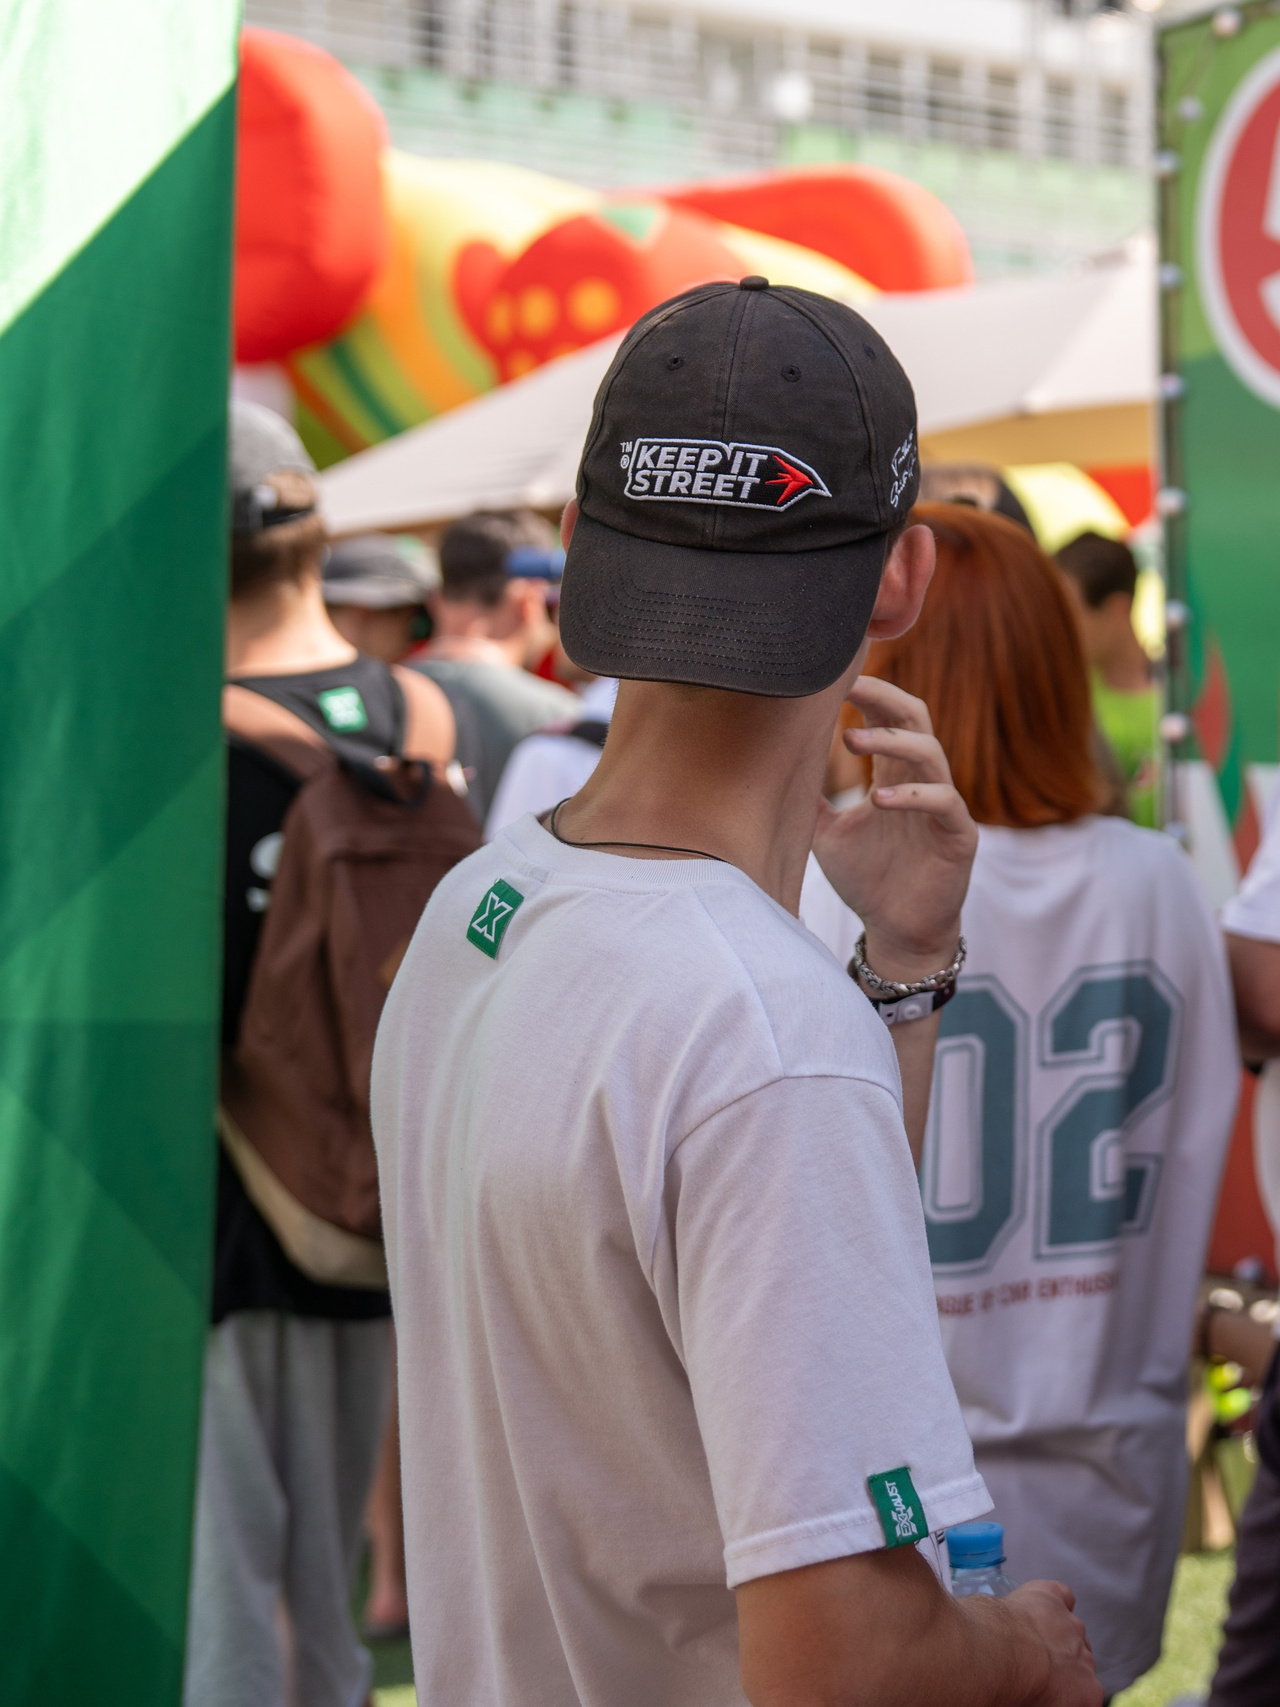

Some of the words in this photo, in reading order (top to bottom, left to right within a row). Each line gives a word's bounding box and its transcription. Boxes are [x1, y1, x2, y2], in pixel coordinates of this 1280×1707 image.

[635, 444, 724, 472] KEEP
[730, 450, 769, 477] IT
[631, 469, 761, 499] STREET
[885, 1480, 918, 1537] EXHAUST
